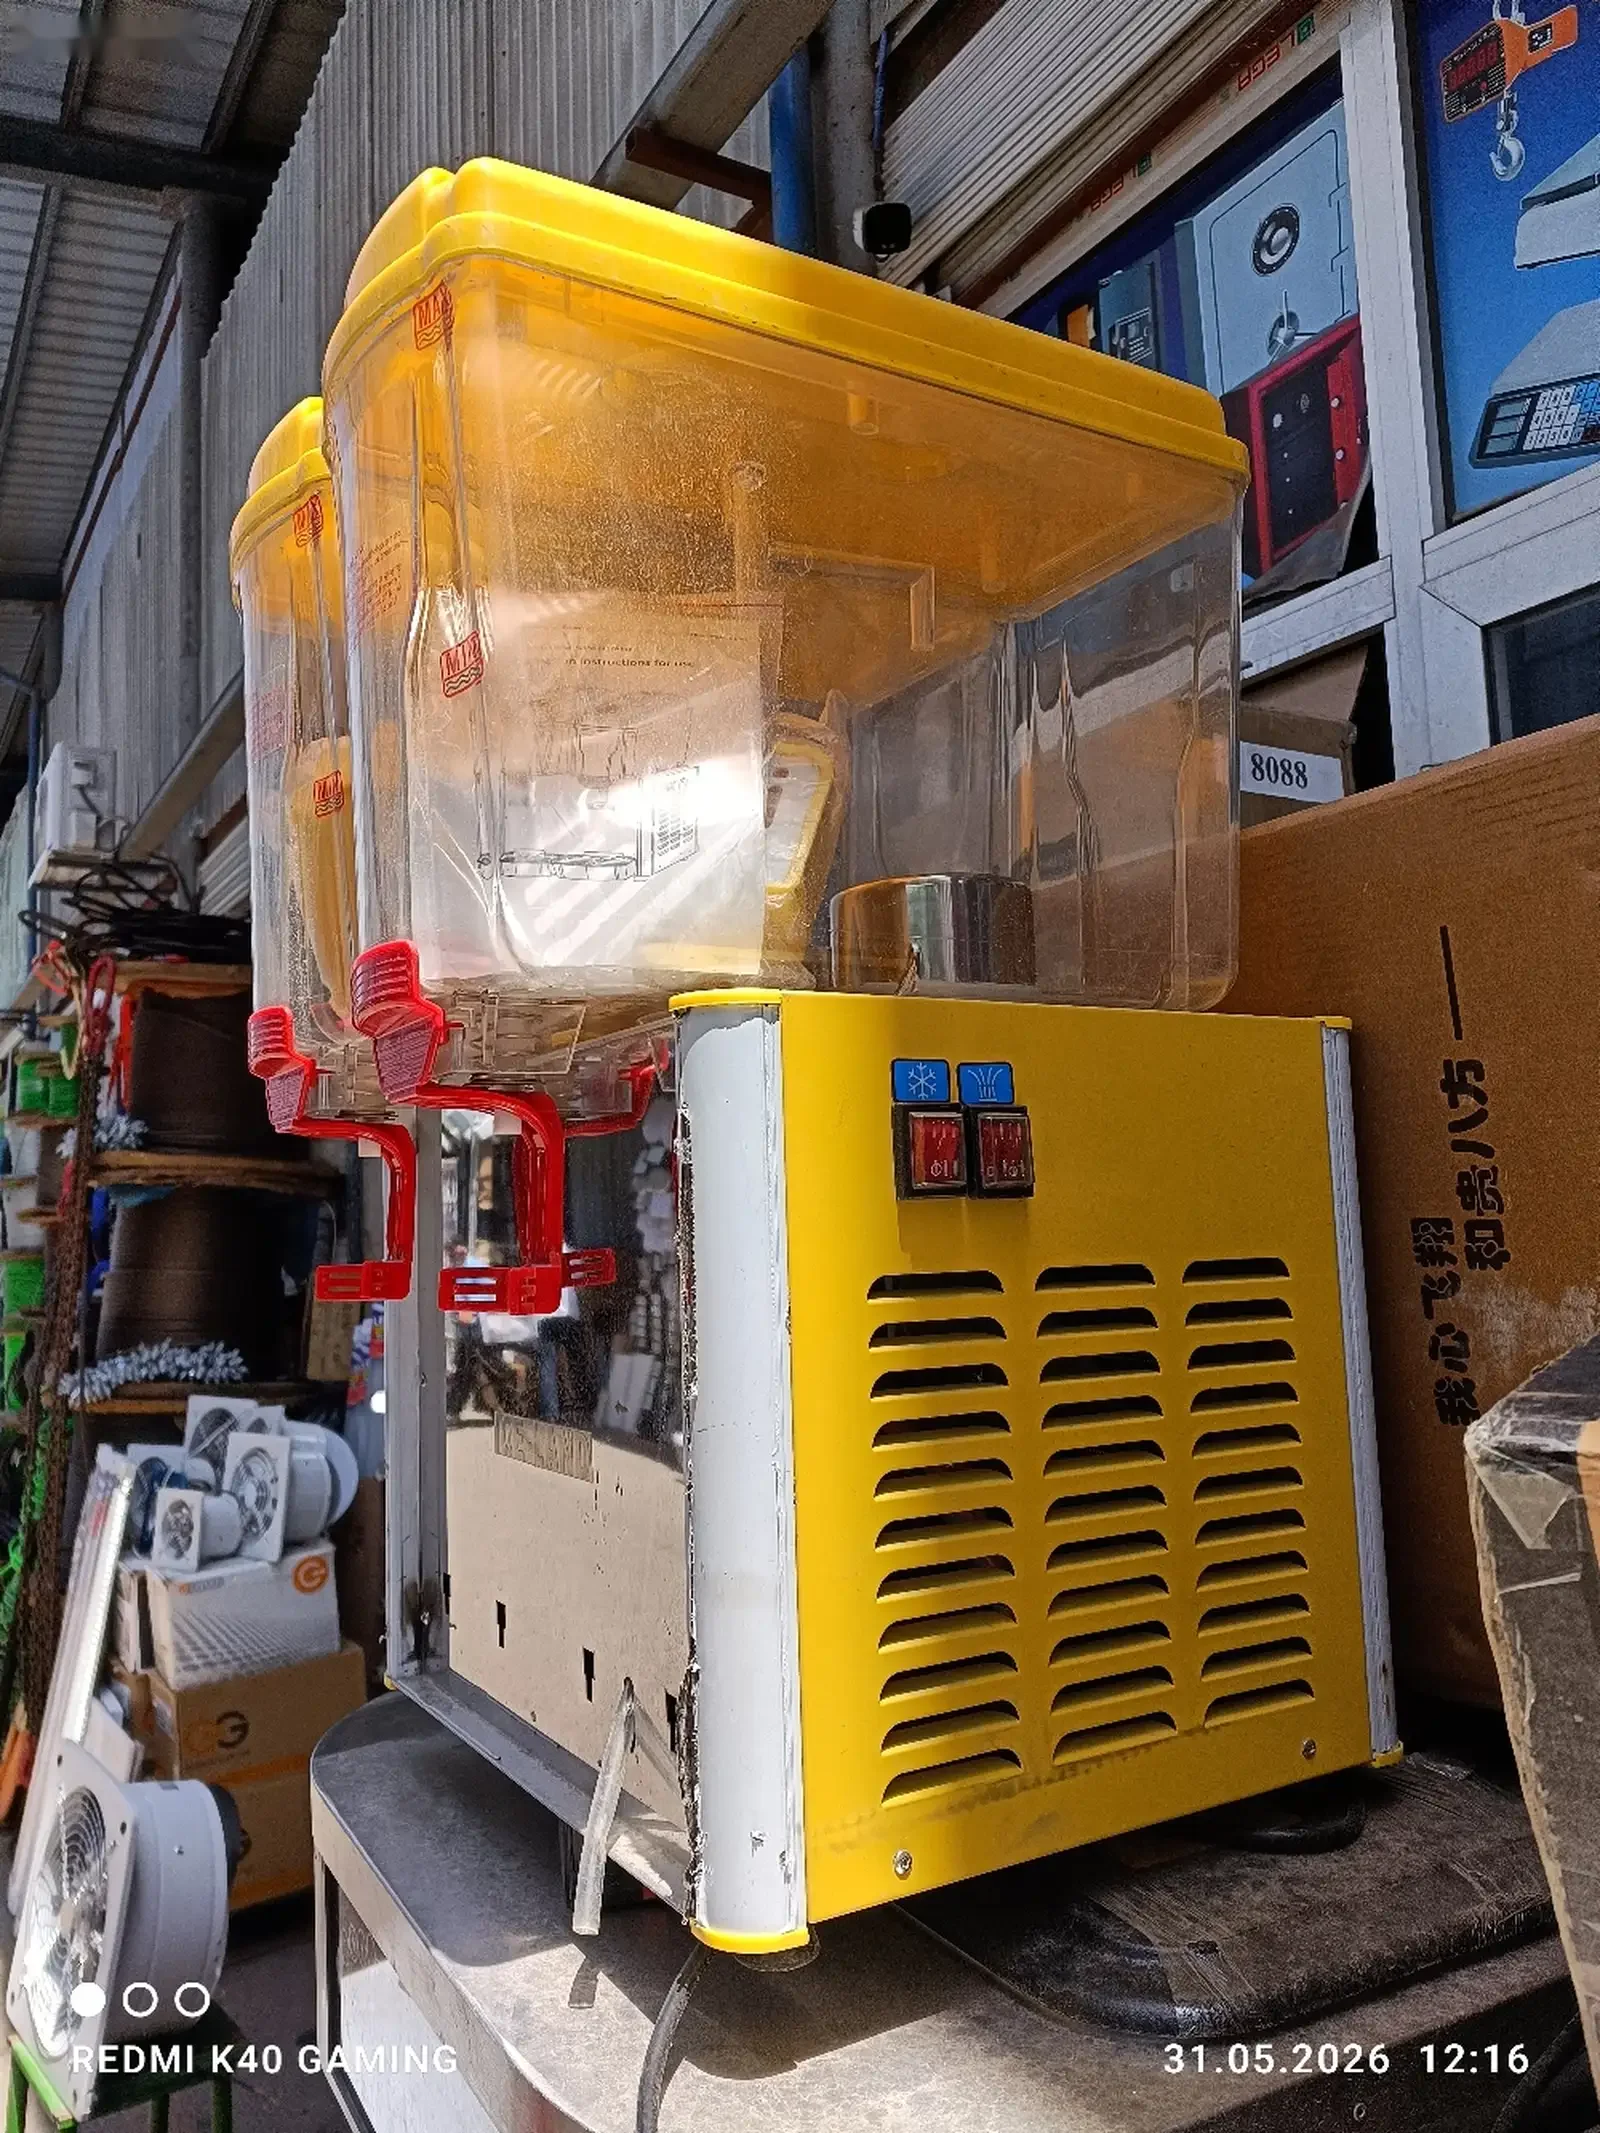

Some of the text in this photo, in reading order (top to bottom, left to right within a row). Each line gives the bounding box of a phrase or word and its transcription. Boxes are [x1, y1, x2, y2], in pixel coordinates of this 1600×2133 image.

[580, 658, 651, 667] instructions
[654, 658, 670, 667] for
[1250, 752, 1308, 789] 8088
[1410, 1216, 1482, 1427] 我心飞翔
